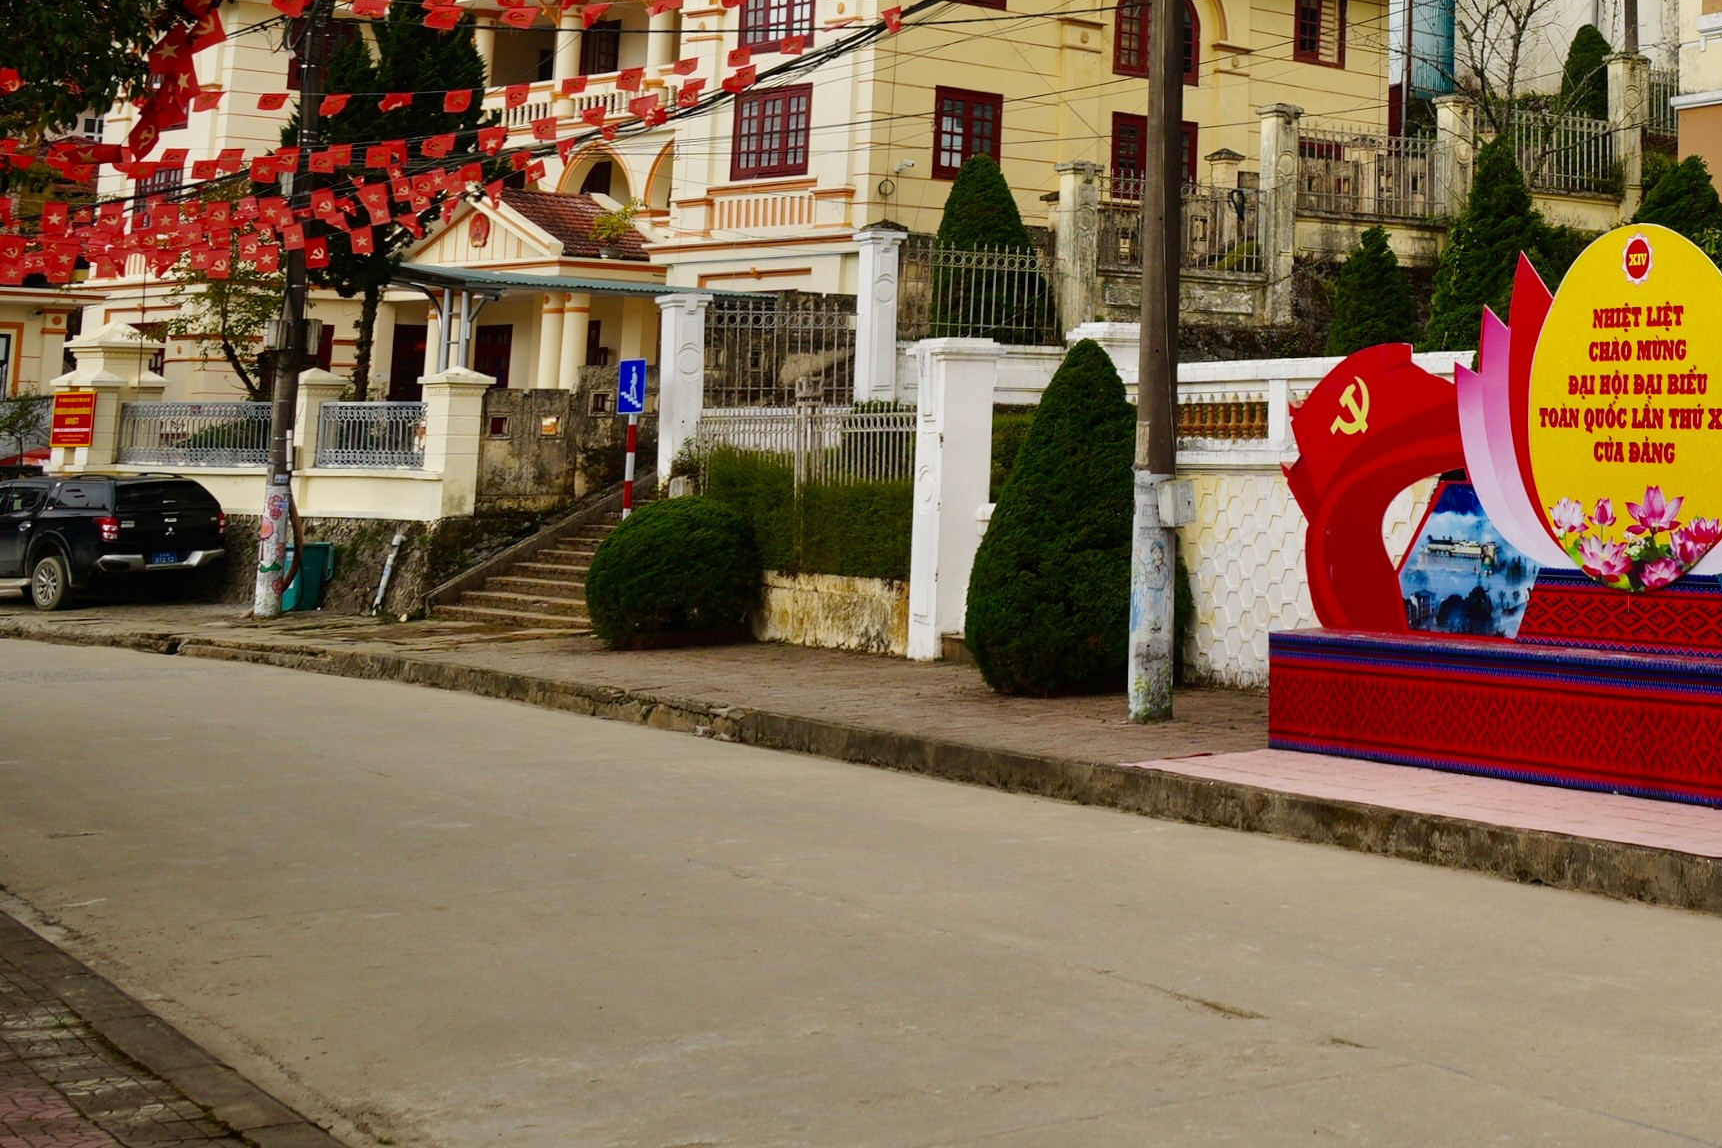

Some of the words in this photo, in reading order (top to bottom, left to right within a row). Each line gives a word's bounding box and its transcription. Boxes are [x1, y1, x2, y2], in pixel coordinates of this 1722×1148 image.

[1628, 252, 1648, 267] XIV
[1592, 302, 1642, 333] NHIỆT
[1645, 301, 1684, 332] LIỆT
[1588, 336, 1632, 361] CHÀO
[1636, 335, 1687, 361] MỪNG
[1568, 374, 1595, 400] ĐẠI
[1599, 369, 1629, 401] HỘI
[1633, 373, 1663, 400] ĐẠI
[1667, 364, 1708, 395] BIỂU
[1539, 402, 1579, 428] TOÀN
[1583, 399, 1627, 433] QUỐC
[1632, 399, 1664, 429] LẦN
[1668, 402, 1705, 430] THỨ
[1593, 435, 1625, 463] CỦA
[1628, 436, 1676, 464] ĐẢNG
